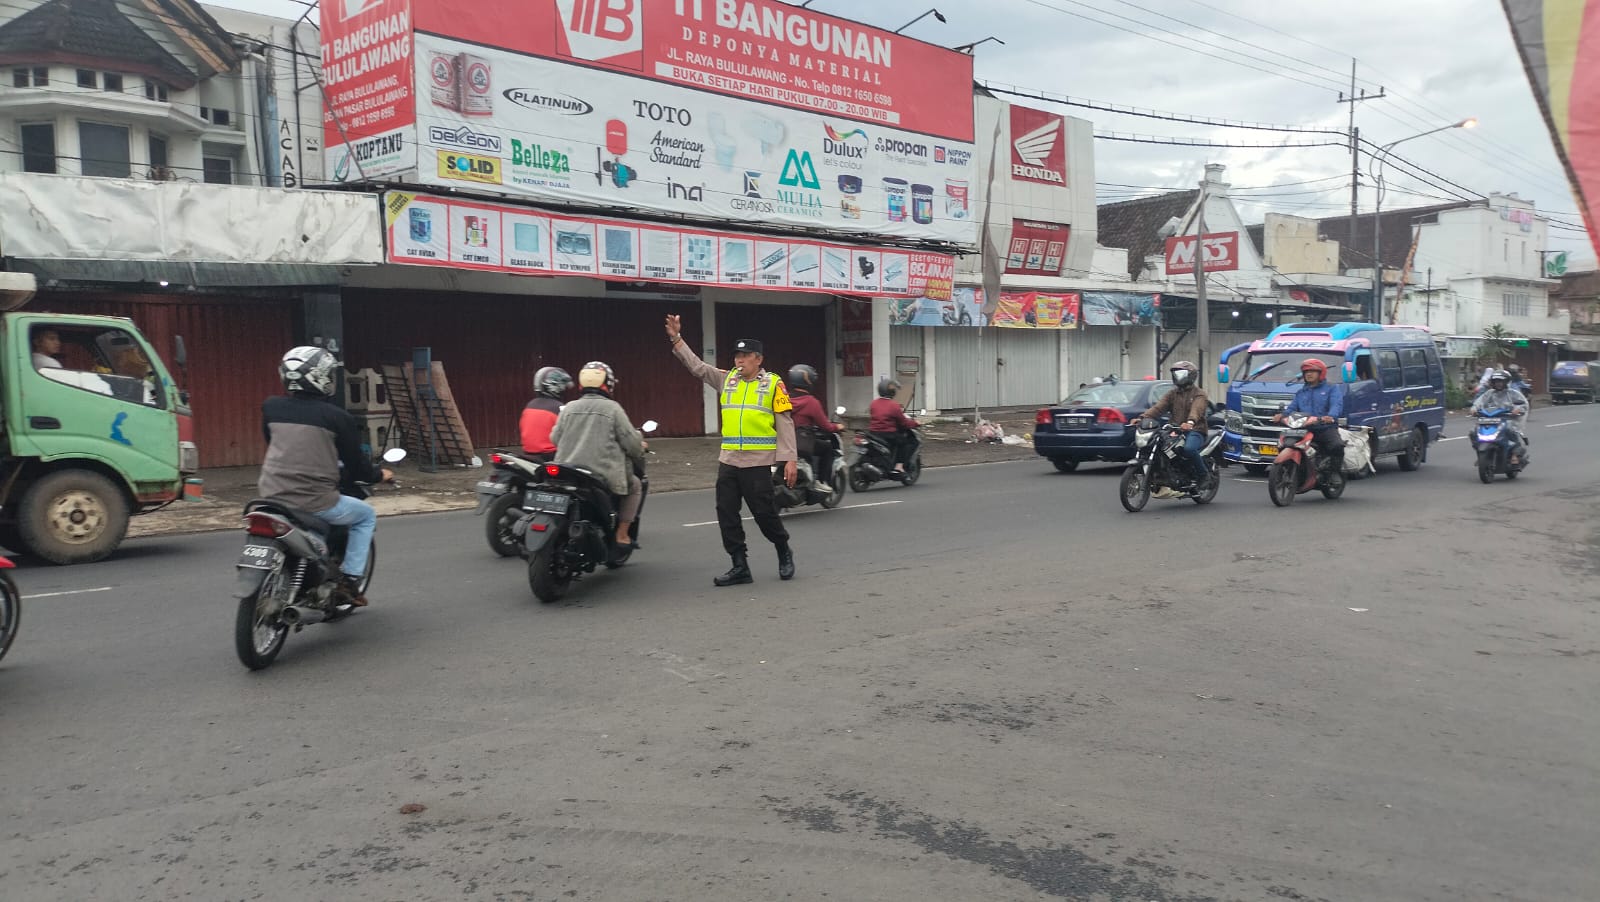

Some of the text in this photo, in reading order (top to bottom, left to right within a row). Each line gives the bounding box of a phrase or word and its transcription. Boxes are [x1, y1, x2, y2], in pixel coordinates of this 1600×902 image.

[333, 10, 409, 60] BANGUNAN
[715, 0, 892, 68] BANGUNAN
[321, 36, 410, 88] BULULAWANG
[682, 26, 881, 85] DEPONYA MATERIAL
[667, 47, 684, 62] JL.
[685, 51, 715, 68] RAYA
[716, 58, 787, 84] BULULAWANG
[794, 76, 810, 89] No.
[812, 79, 831, 96] Telp
[831, 83, 852, 98] 0812
[344, 101, 364, 116] PASAR
[364, 86, 408, 110] BULULAWANG
[513, 91, 583, 112] PLATINUM
[672, 67, 705, 84] BUKA
[708, 75, 746, 92] SETIAP
[749, 84, 774, 98] HARI
[777, 90, 811, 106] PUKUL
[813, 97, 838, 110] 07.00
[846, 104, 869, 116] 20.00
[871, 109, 888, 120] WIB
[633, 100, 692, 127] TOTO
[356, 132, 403, 161] KOPTANU
[650, 130, 705, 153] American
[823, 137, 863, 159] Dulux
[885, 138, 928, 158] propan
[510, 138, 570, 173] Belleza
[649, 147, 702, 169] Standard
[947, 149, 972, 159] NIPPON
[949, 157, 968, 167] PAINT
[1012, 164, 1064, 183] HONDA
[666, 177, 703, 202] ina
[776, 189, 823, 209] MULIA
[776, 206, 823, 217] CERAMICS
[910, 261, 953, 280] BELANJA
